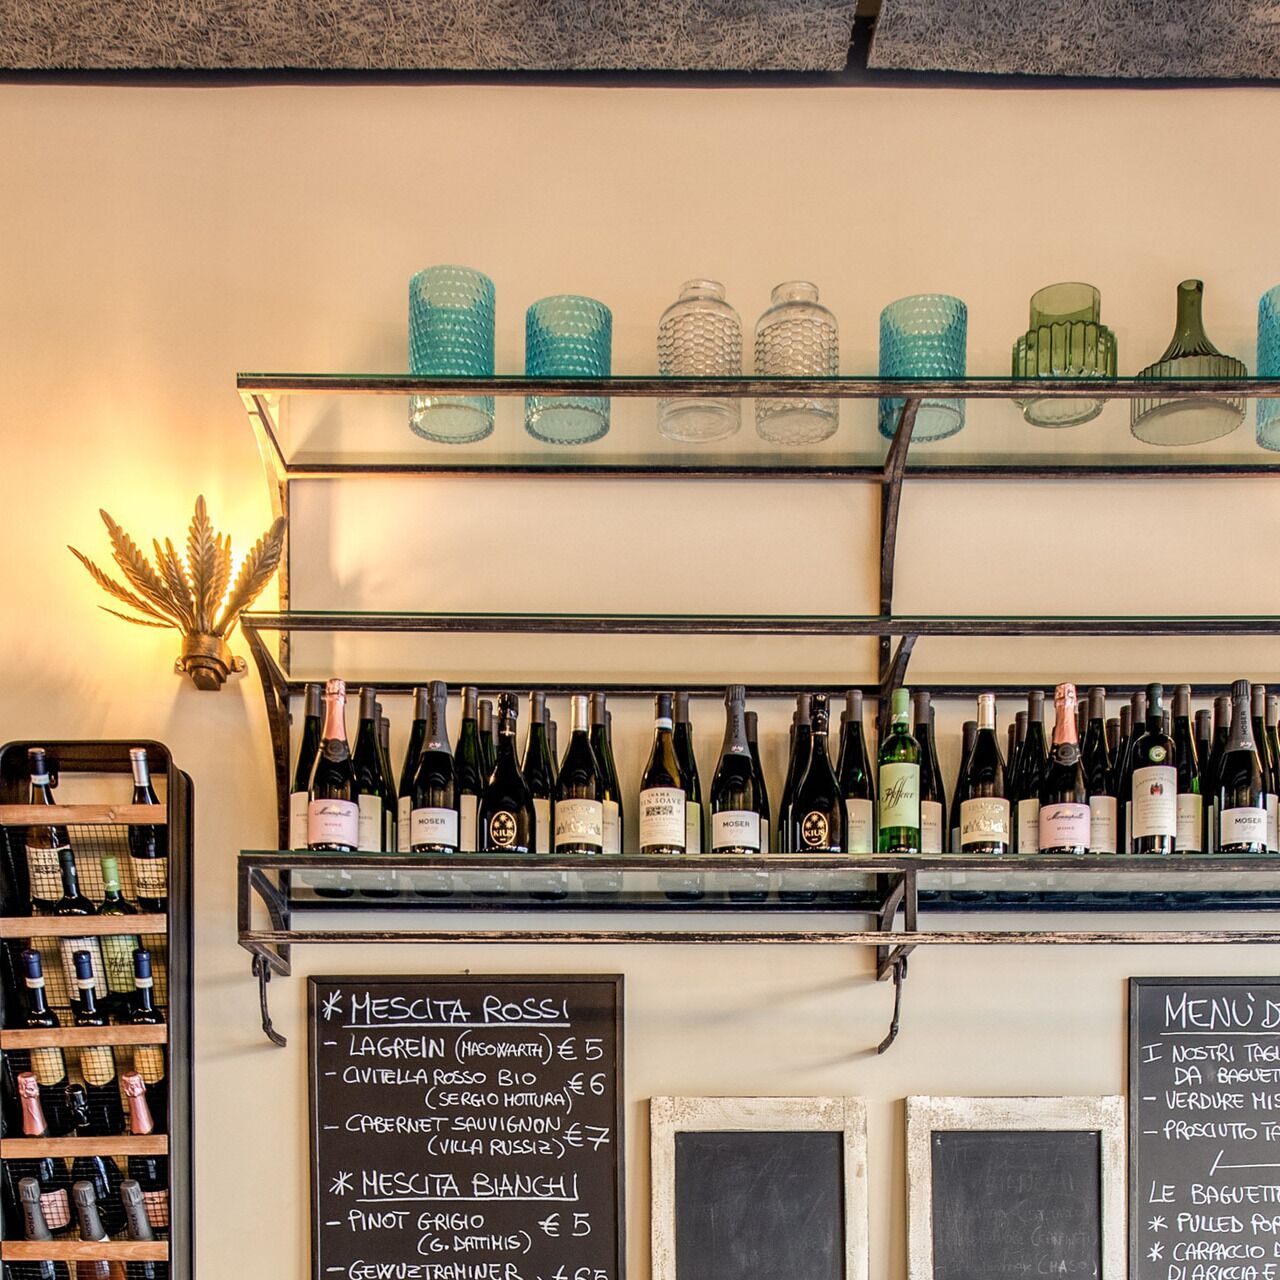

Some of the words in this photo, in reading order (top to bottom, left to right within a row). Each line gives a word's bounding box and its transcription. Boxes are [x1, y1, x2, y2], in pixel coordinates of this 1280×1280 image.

[722, 820, 750, 828] MOSER
[1234, 816, 1262, 825] MOSER
[804, 829, 825, 838] KIUS
[351, 991, 472, 1025] MESCITA
[482, 994, 569, 1023] ROSSI
[349, 1034, 445, 1059] LAGREIN
[1142, 1042, 1163, 1063] I
[1172, 1042, 1235, 1063] NOSTRI
[342, 1065, 428, 1085] CIVITELLA
[433, 1068, 487, 1086] ROSSO
[498, 1068, 537, 1087] BIO
[1174, 1065, 1202, 1086] DA
[424, 1086, 499, 1110] (SERGIO
[503, 1085, 575, 1115] MOTTURA)
[1165, 1090, 1244, 1111] VERDURE
[345, 1113, 449, 1134] CABERNET
[451, 1115, 561, 1133] SAUVIGNON
[1162, 1119, 1258, 1141] PROSCIUTTO
[427, 1134, 483, 1156] (VILLA
[489, 1137, 566, 1159] RUSSIZ)
[362, 1171, 460, 1197] MESCITA
[470, 1172, 579, 1200] BIANCHI
[1148, 1180, 1176, 1203] LE
[347, 1209, 410, 1232] PINOT
[417, 1212, 485, 1231] GRIGIO
[1176, 1212, 1244, 1233] PULLED
[1172, 1241, 1265, 1262] CARPACCIO
